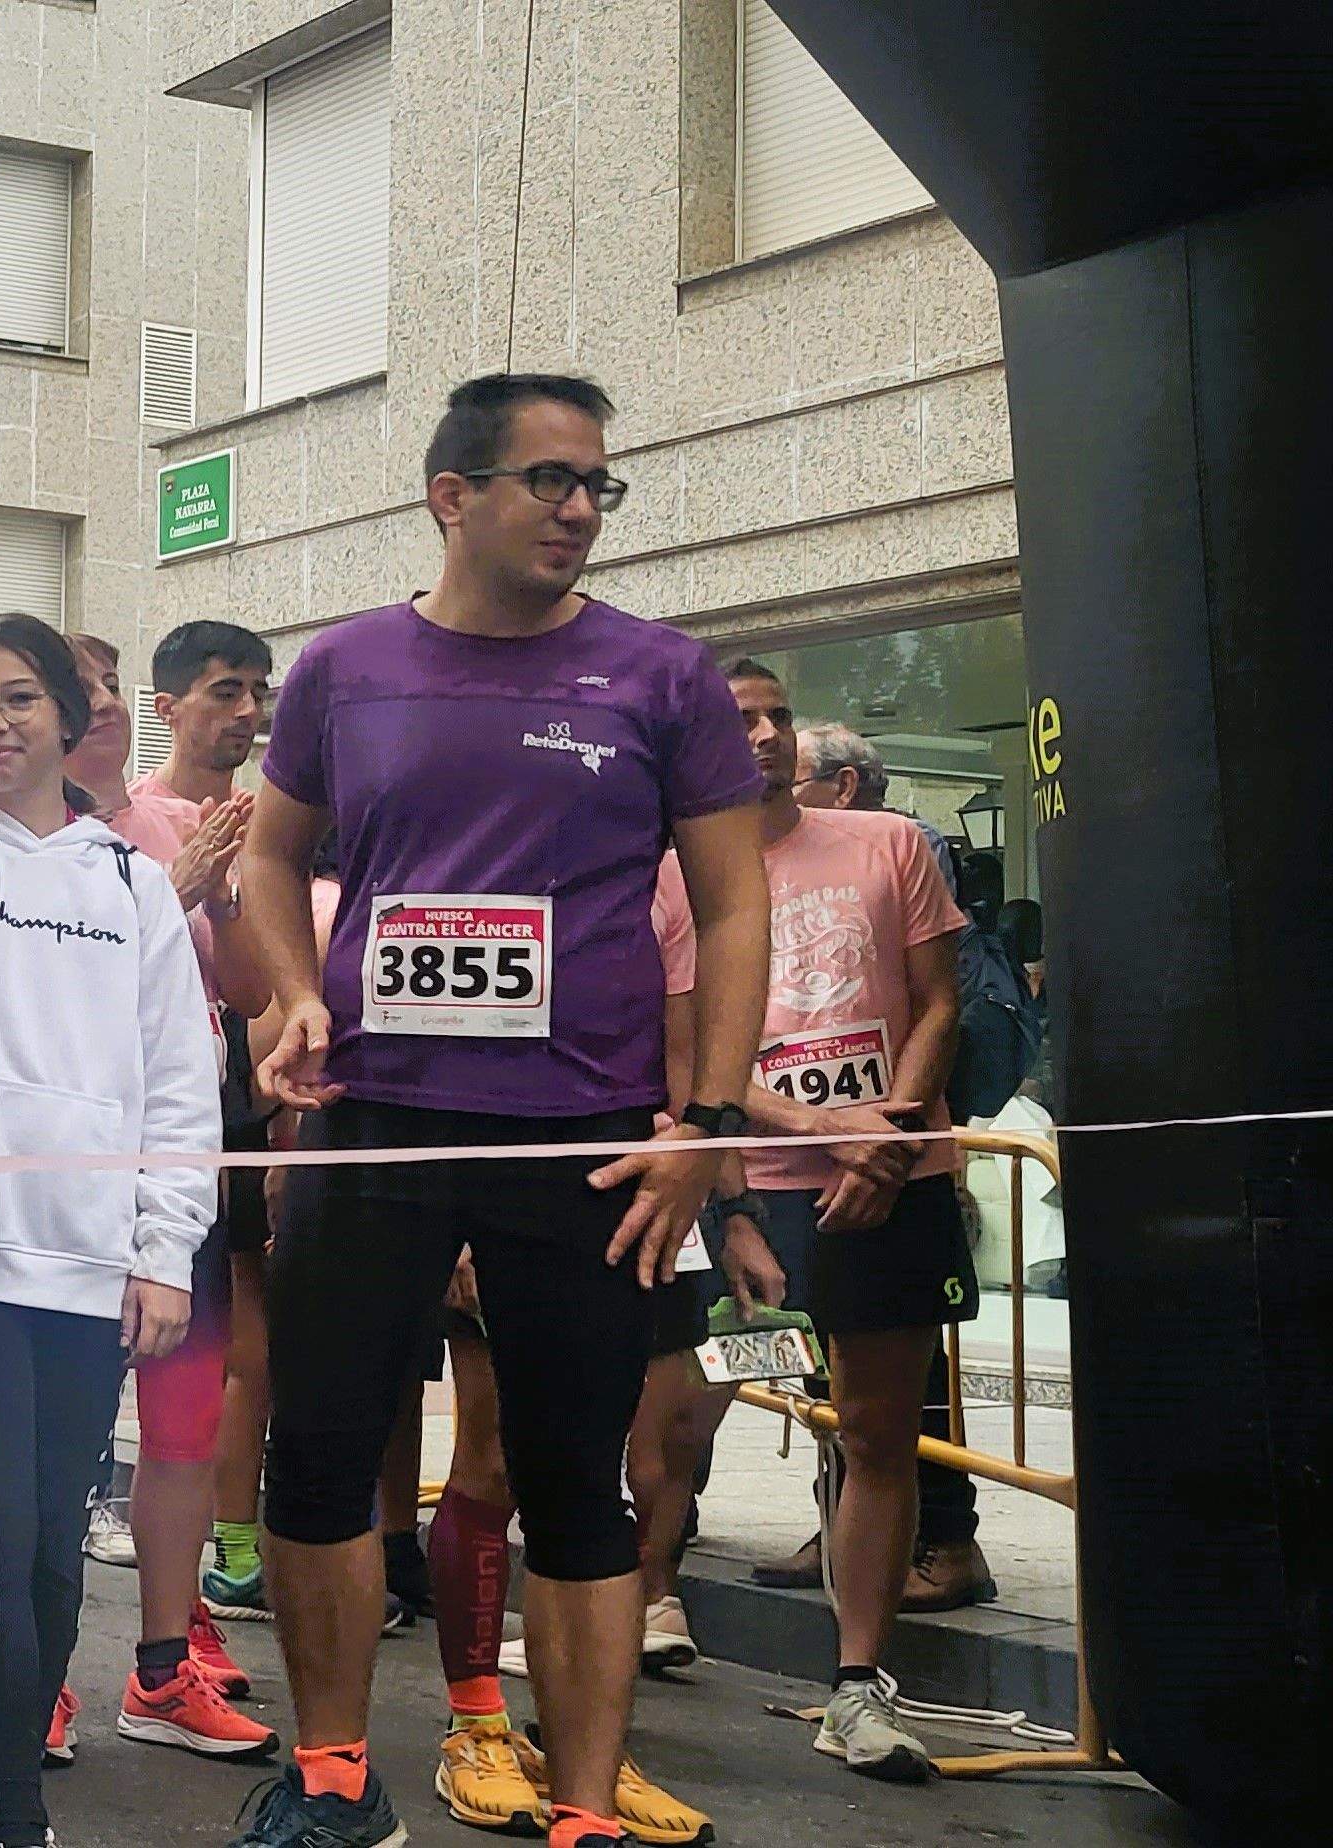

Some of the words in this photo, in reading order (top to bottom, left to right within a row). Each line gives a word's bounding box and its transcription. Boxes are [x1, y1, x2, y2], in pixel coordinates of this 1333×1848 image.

[181, 483, 210, 502] PLAZA
[174, 498, 217, 520] NAVARRA
[424, 910, 475, 922] HUESCA
[383, 922, 436, 936] CONTRA
[440, 923, 460, 936] EL
[464, 920, 535, 938] CÁNCER
[376, 945, 534, 999] 3855
[766, 1050, 816, 1070] CONTRA
[818, 1047, 833, 1059] EL
[773, 1058, 884, 1106] 1941
